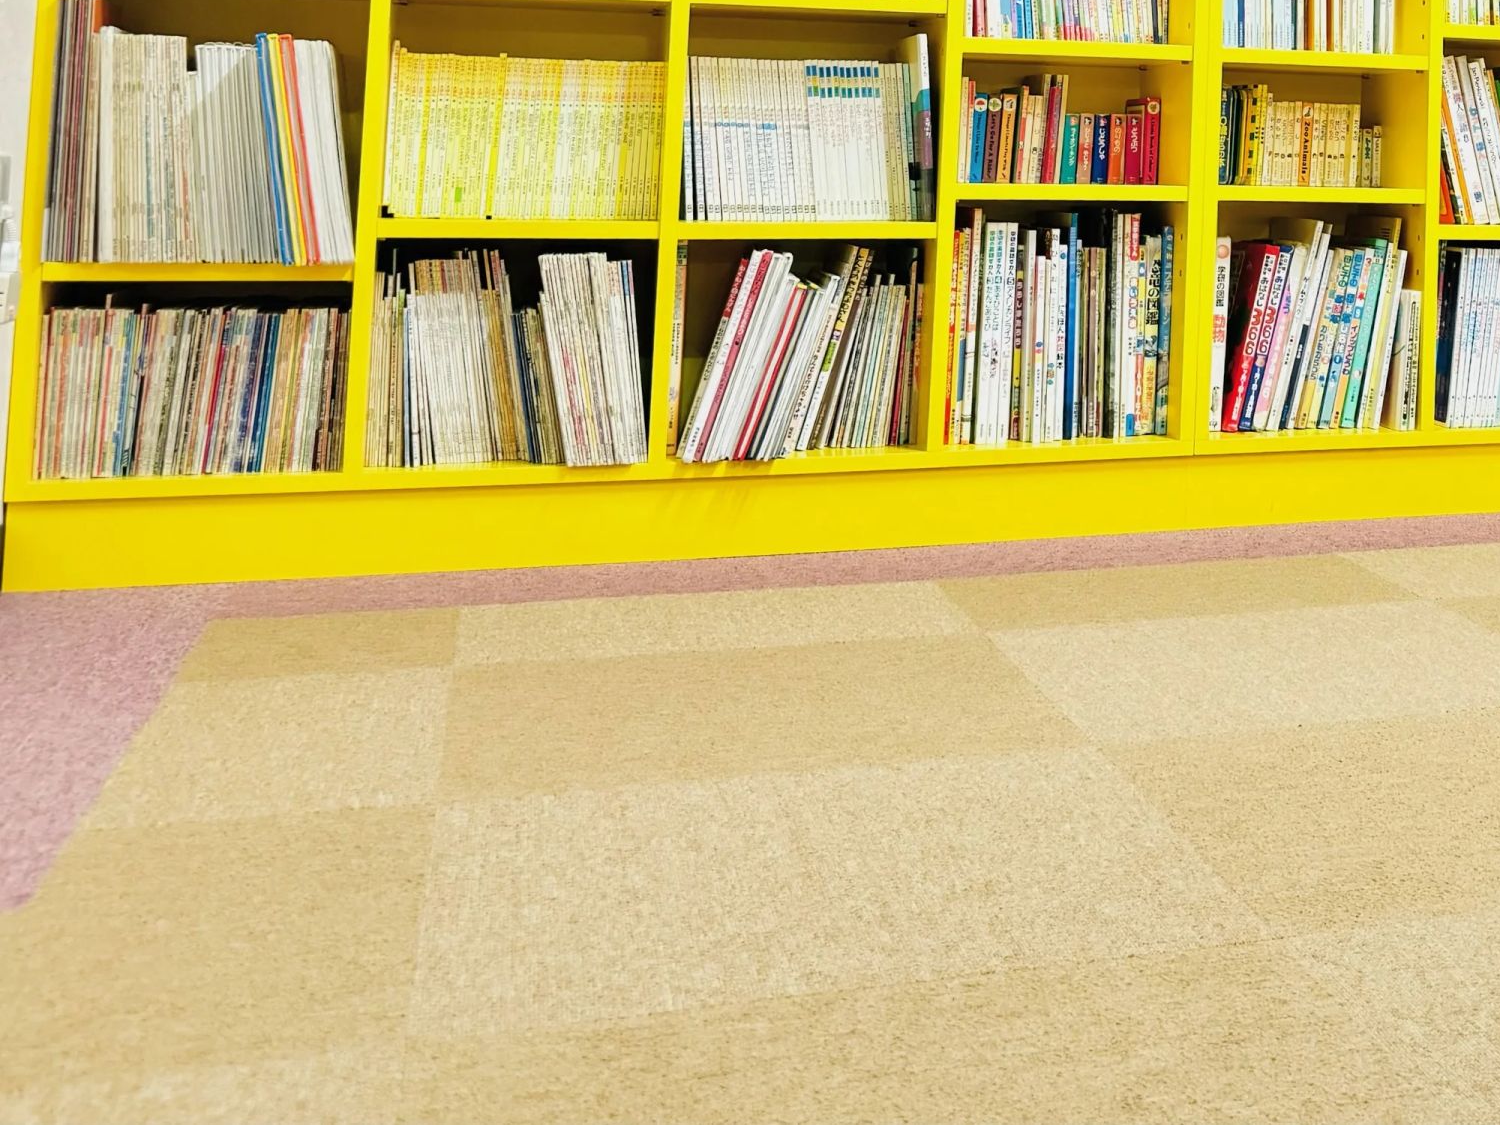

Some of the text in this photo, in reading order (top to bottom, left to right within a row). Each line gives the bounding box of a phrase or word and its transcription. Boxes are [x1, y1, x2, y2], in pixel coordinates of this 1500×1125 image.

[1302, 138, 1310, 174] Animals
[1145, 259, 1162, 325] 恐竜の図鑑
